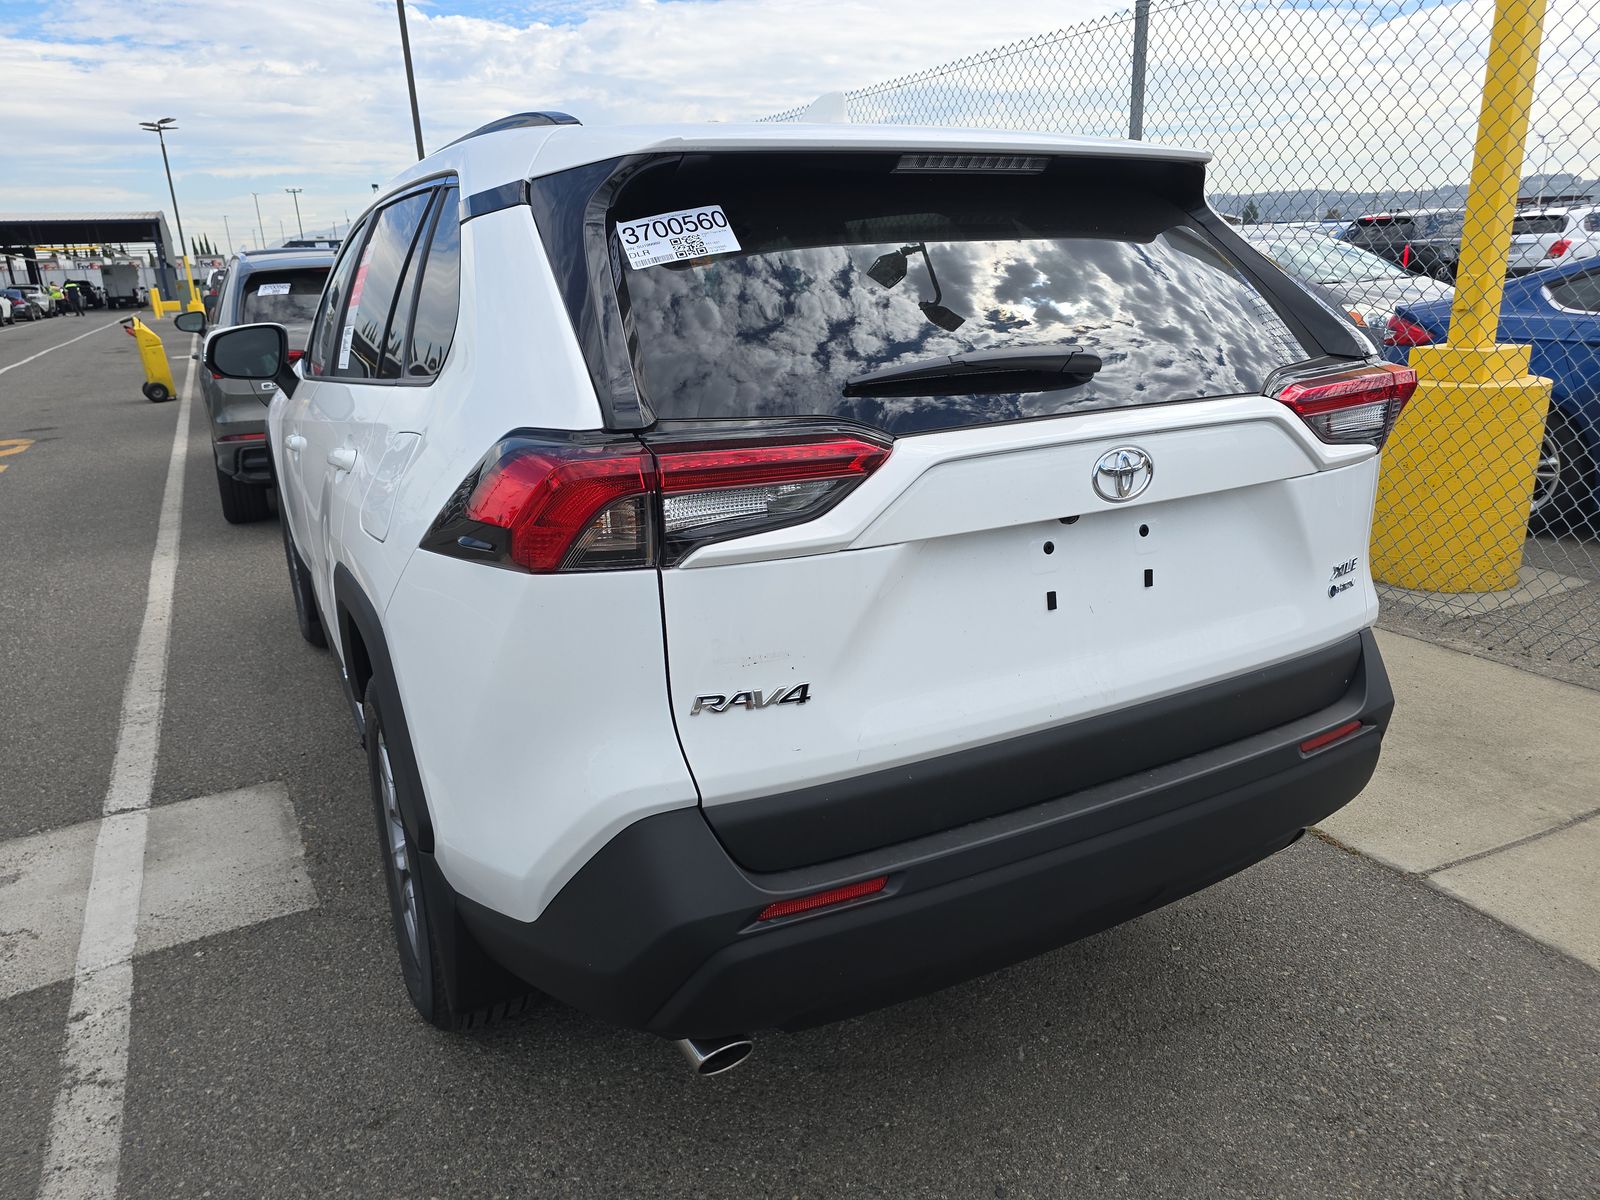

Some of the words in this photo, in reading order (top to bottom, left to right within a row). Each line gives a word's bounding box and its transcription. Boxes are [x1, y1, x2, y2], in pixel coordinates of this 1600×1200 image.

[622, 210, 728, 245] 3700560
[628, 249, 651, 259] DLR
[1330, 557, 1358, 582] XLE
[690, 681, 812, 716] RAV4
